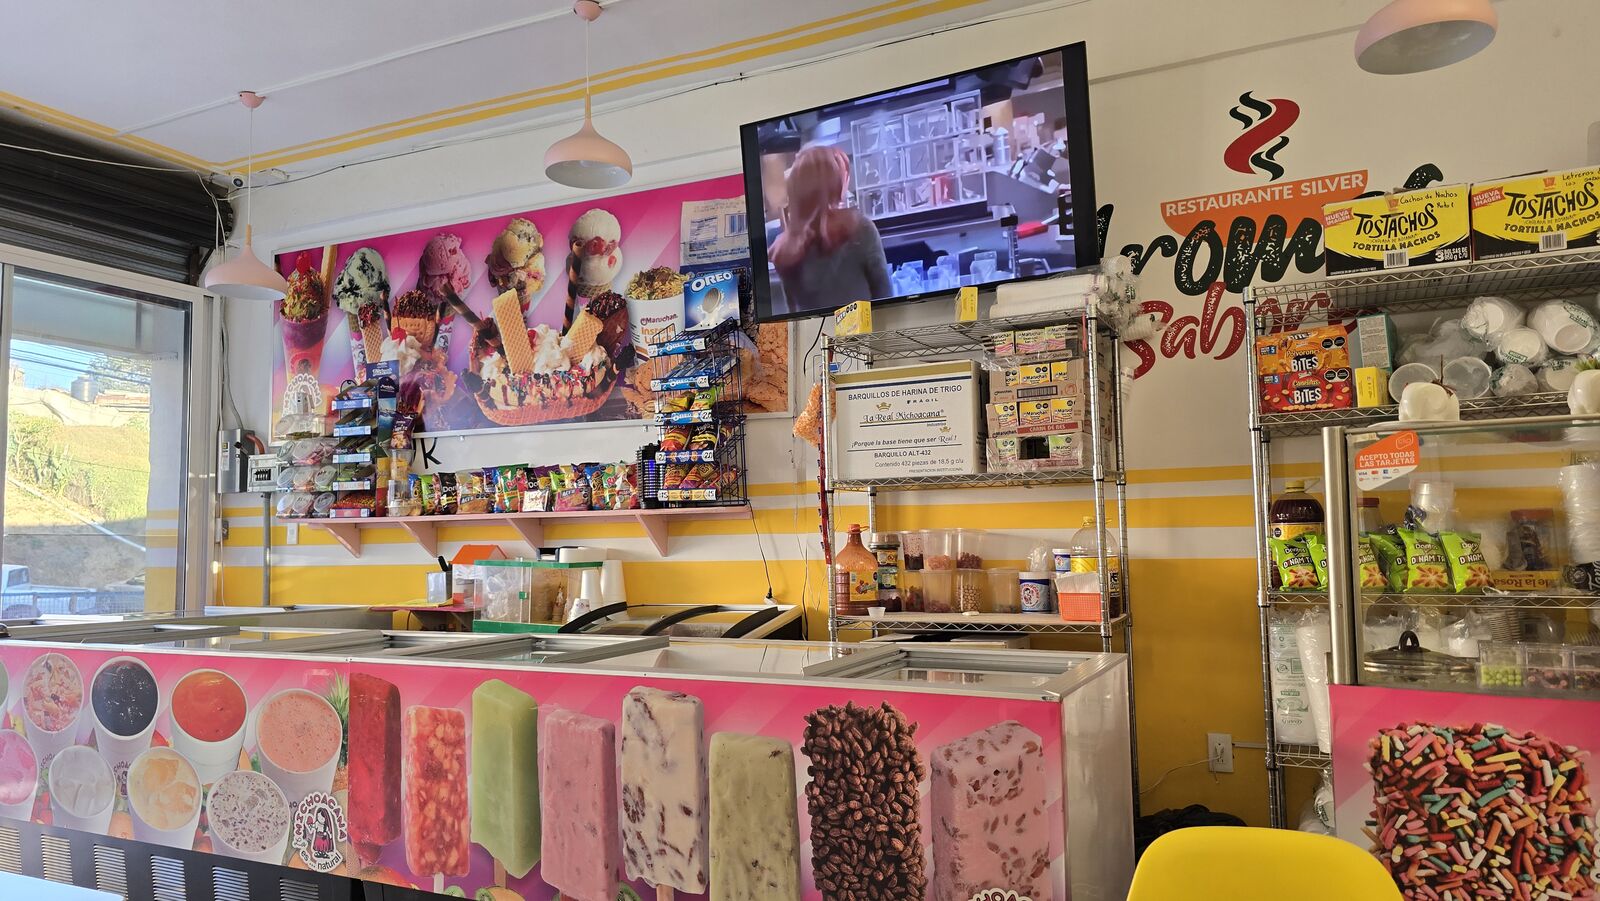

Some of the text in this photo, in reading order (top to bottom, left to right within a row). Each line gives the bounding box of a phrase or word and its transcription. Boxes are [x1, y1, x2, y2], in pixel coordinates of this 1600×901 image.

[1165, 173, 1365, 217] RESTAURANTE SILVER
[1473, 190, 1500, 202] NUEVA
[1475, 195, 1501, 207] IMAGEN
[1504, 181, 1599, 220] TOSTACHOS
[1325, 209, 1349, 222] NUEVA
[1327, 214, 1351, 226] IMAGEN
[1353, 202, 1439, 239] TOSTACHOS
[1504, 211, 1600, 234] TORTILLA NACHOS
[1353, 231, 1441, 252] TORTILLA NACHOS
[691, 272, 733, 292] OREO
[645, 313, 677, 323] Maruchan
[1291, 356, 1319, 372] BITES
[848, 391, 890, 401] BARQUILLOS
[891, 390, 900, 398] DE
[902, 388, 928, 396] HARINA
[940, 385, 962, 393] TRIGO
[1293, 388, 1322, 404] BITES
[875, 413, 894, 423] Real
[874, 449, 932, 459] BARQUILLO ALT-432
[1360, 450, 1415, 461] ACEPTO TODAS
[1360, 457, 1415, 468] LAS TARJETAS
[295, 793, 347, 840] MICHOACANA
[301, 850, 342, 870] es natural
